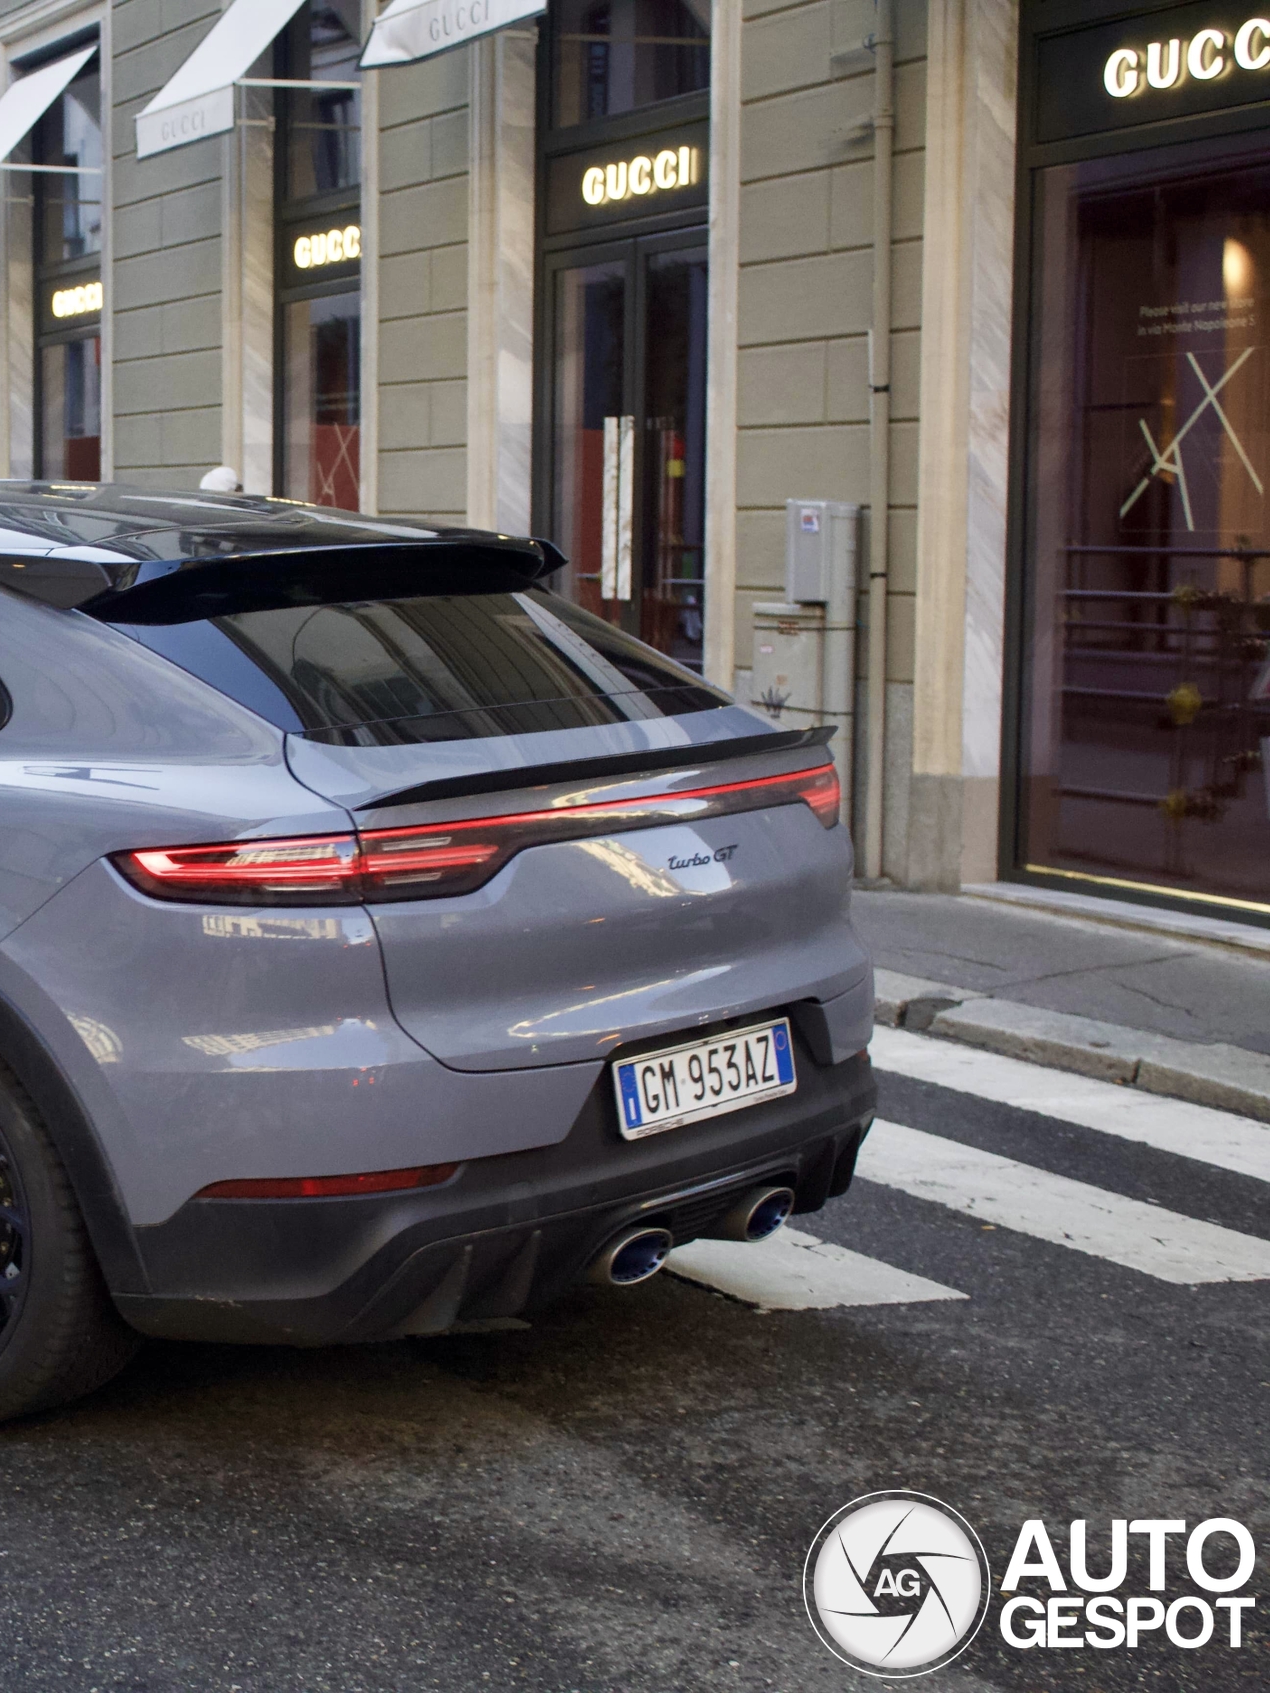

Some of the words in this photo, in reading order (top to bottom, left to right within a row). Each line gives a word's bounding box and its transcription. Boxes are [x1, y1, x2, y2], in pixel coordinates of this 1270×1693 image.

[429, 0, 489, 41] GUCCI
[1104, 18, 1270, 97] GUCC
[161, 110, 206, 141] GUCCI
[582, 146, 692, 205] GUCCI
[294, 225, 362, 269] GUCC
[52, 282, 103, 318] GUCCI
[1139, 305, 1169, 318] Please
[713, 844, 739, 862] GT
[641, 1059, 680, 1114] GM
[688, 1034, 775, 1101] 953AZ
[636, 1118, 684, 1137] PORSCHE
